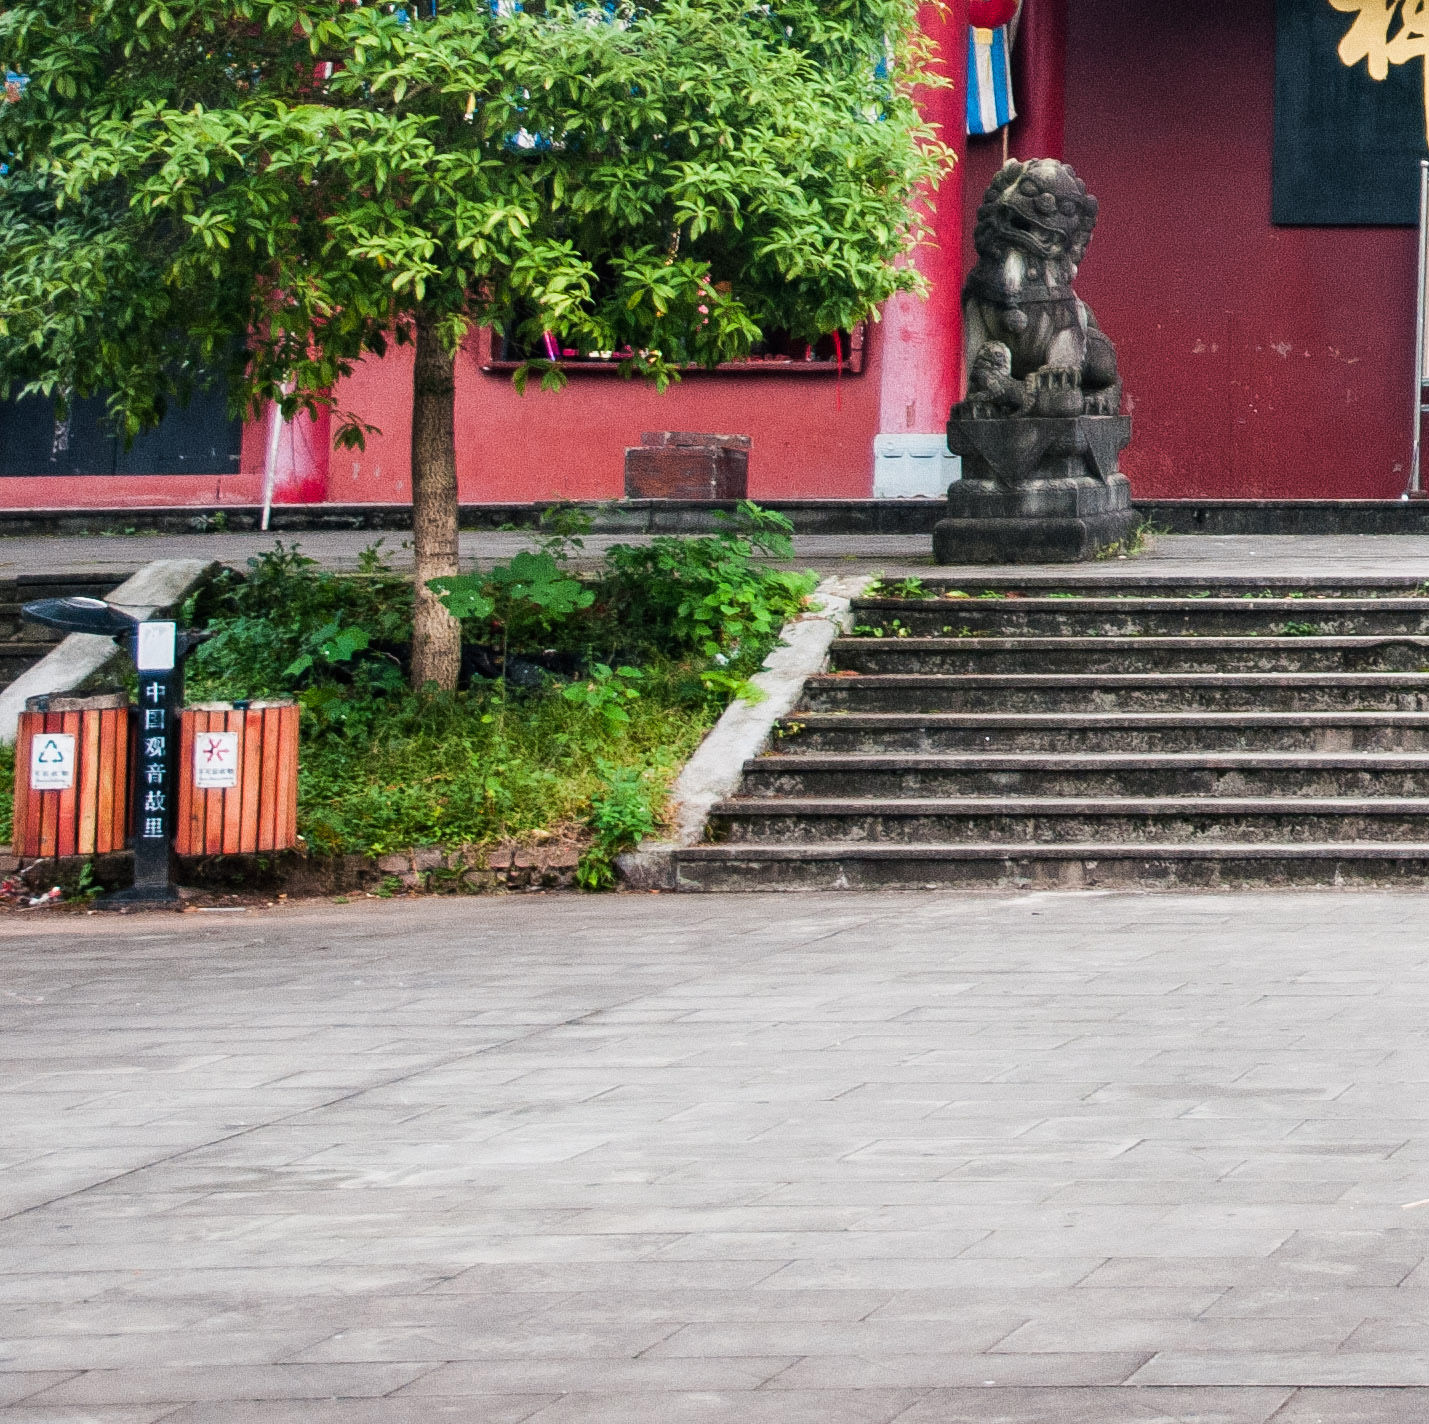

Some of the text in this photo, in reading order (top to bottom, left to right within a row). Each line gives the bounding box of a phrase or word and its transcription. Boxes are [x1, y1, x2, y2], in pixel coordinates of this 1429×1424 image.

[142, 681, 166, 838] 中国观音故里
